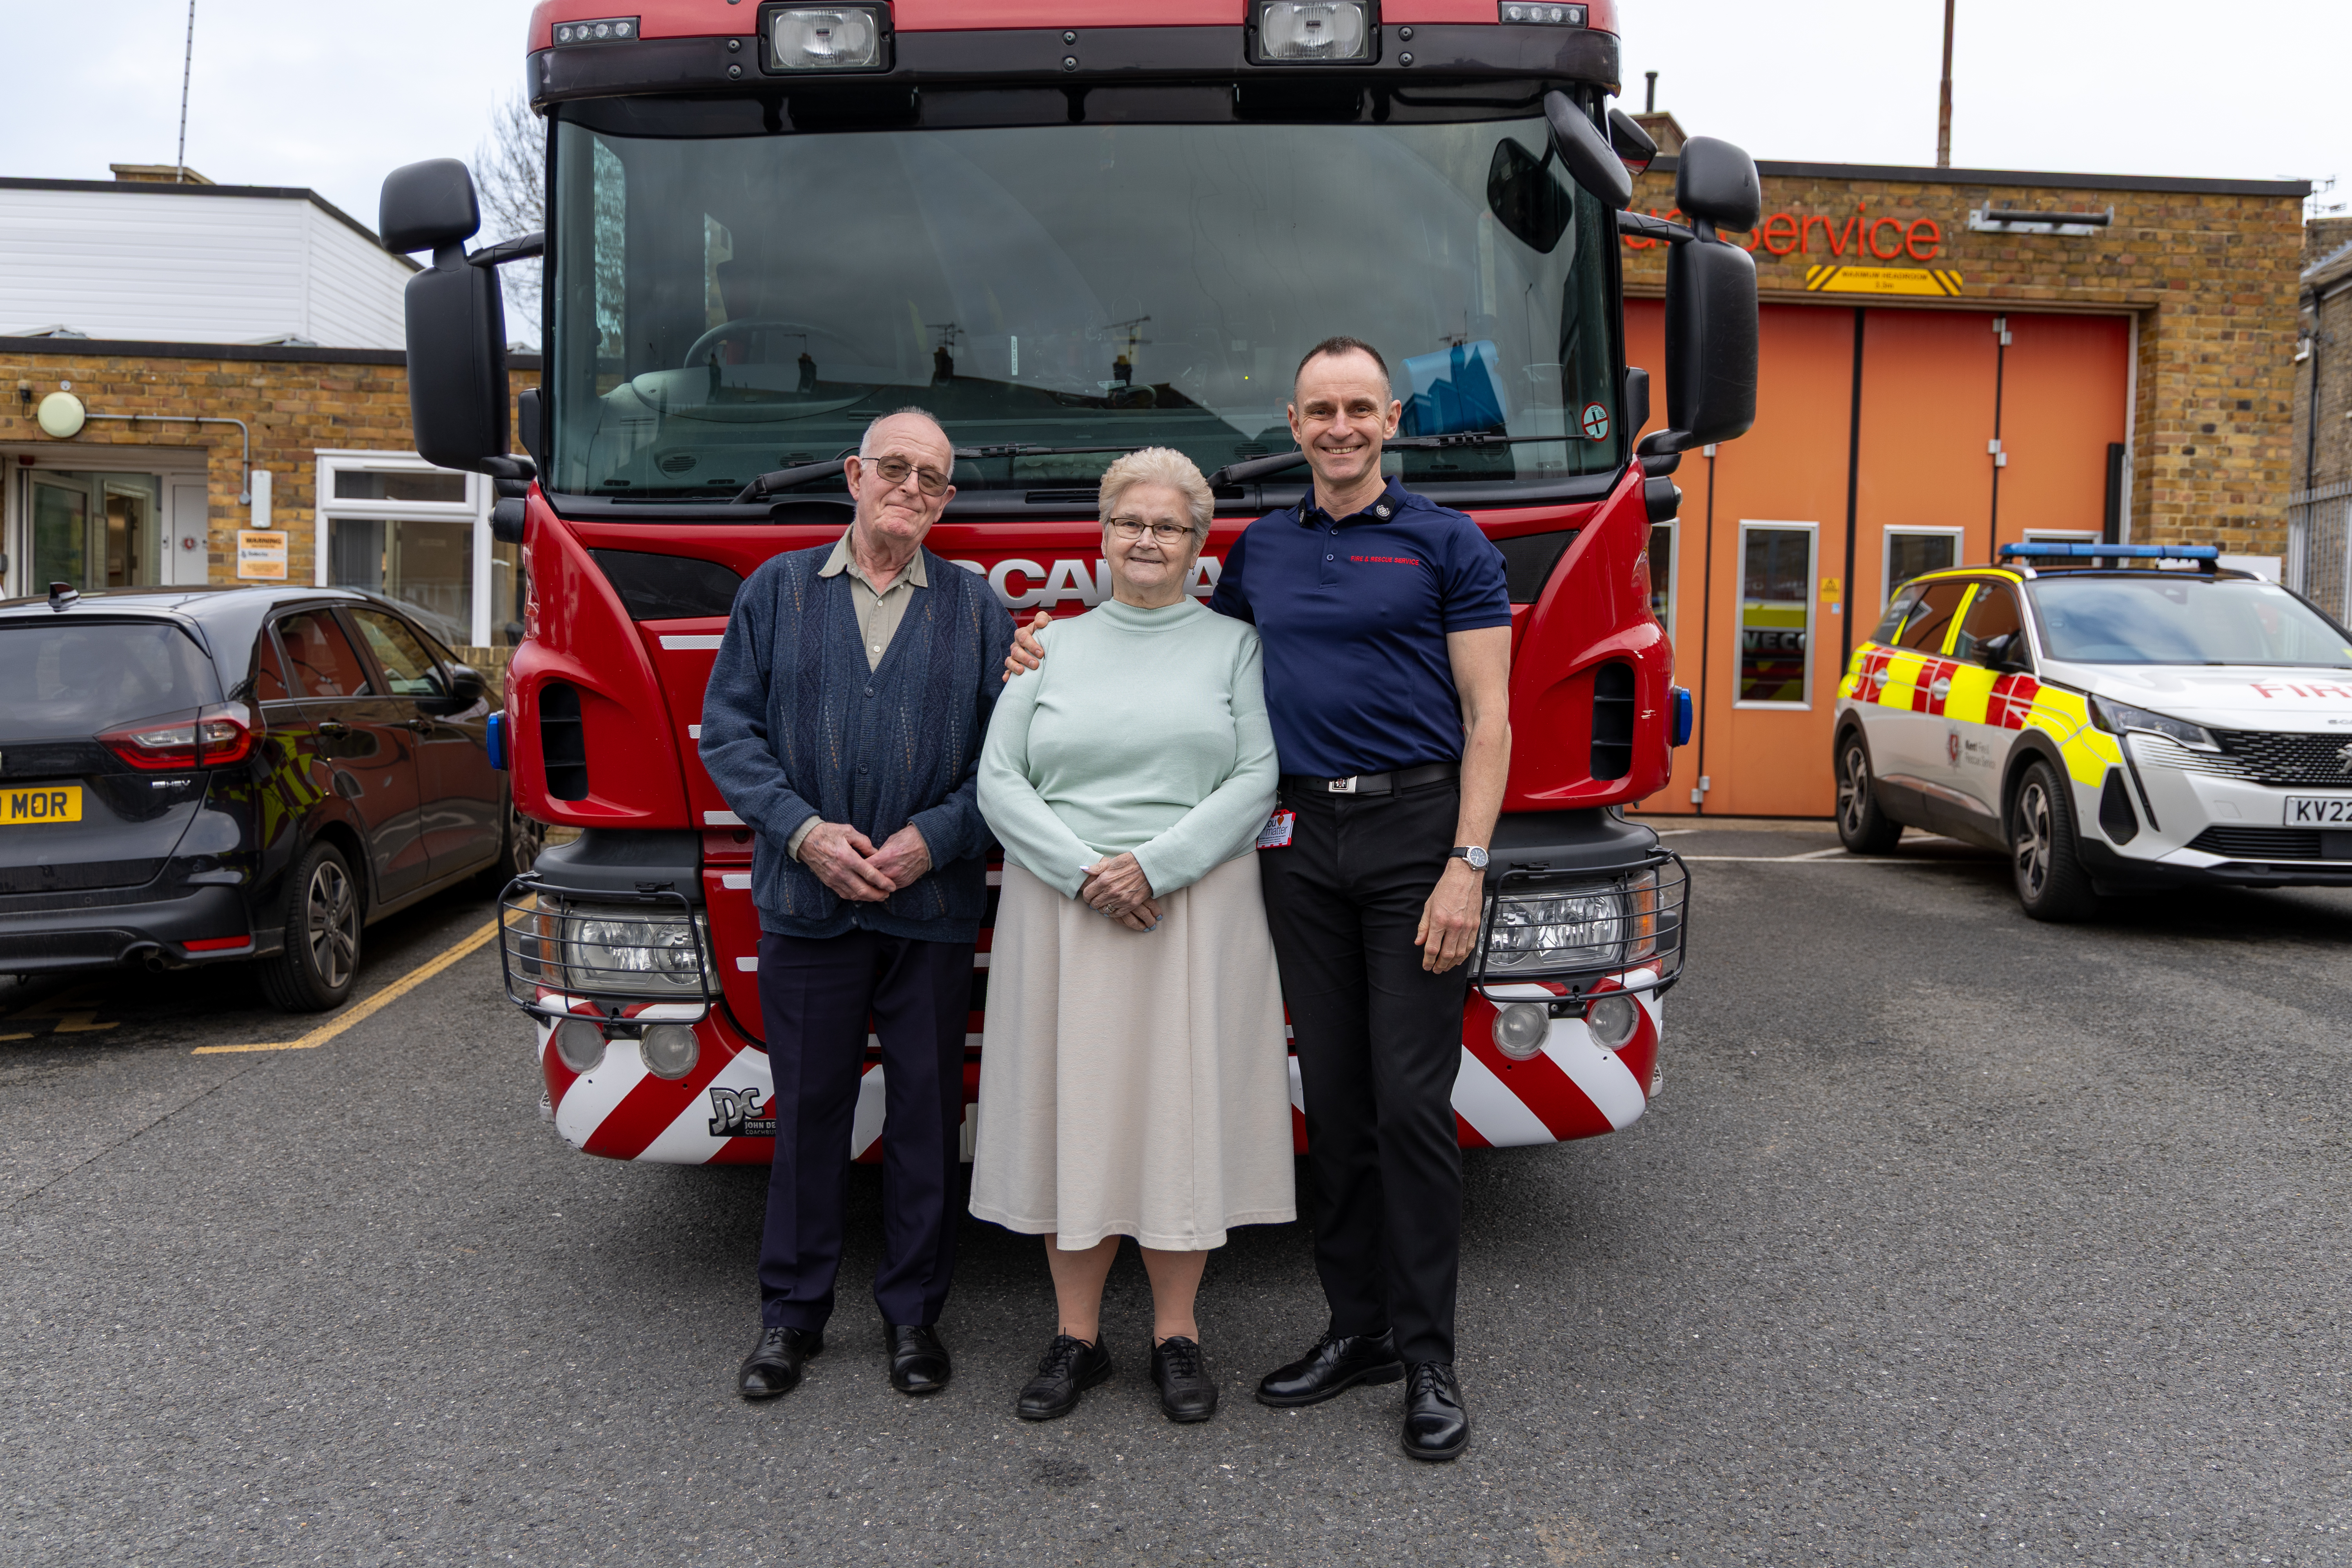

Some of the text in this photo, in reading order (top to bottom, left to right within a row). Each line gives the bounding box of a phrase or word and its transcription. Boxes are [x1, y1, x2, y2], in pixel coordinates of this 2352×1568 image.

[948, 555, 1222, 609] CAA
[2250, 684, 2352, 698] FIR
[11, 792, 67, 818] MOR
[1266, 826, 1288, 836] matter
